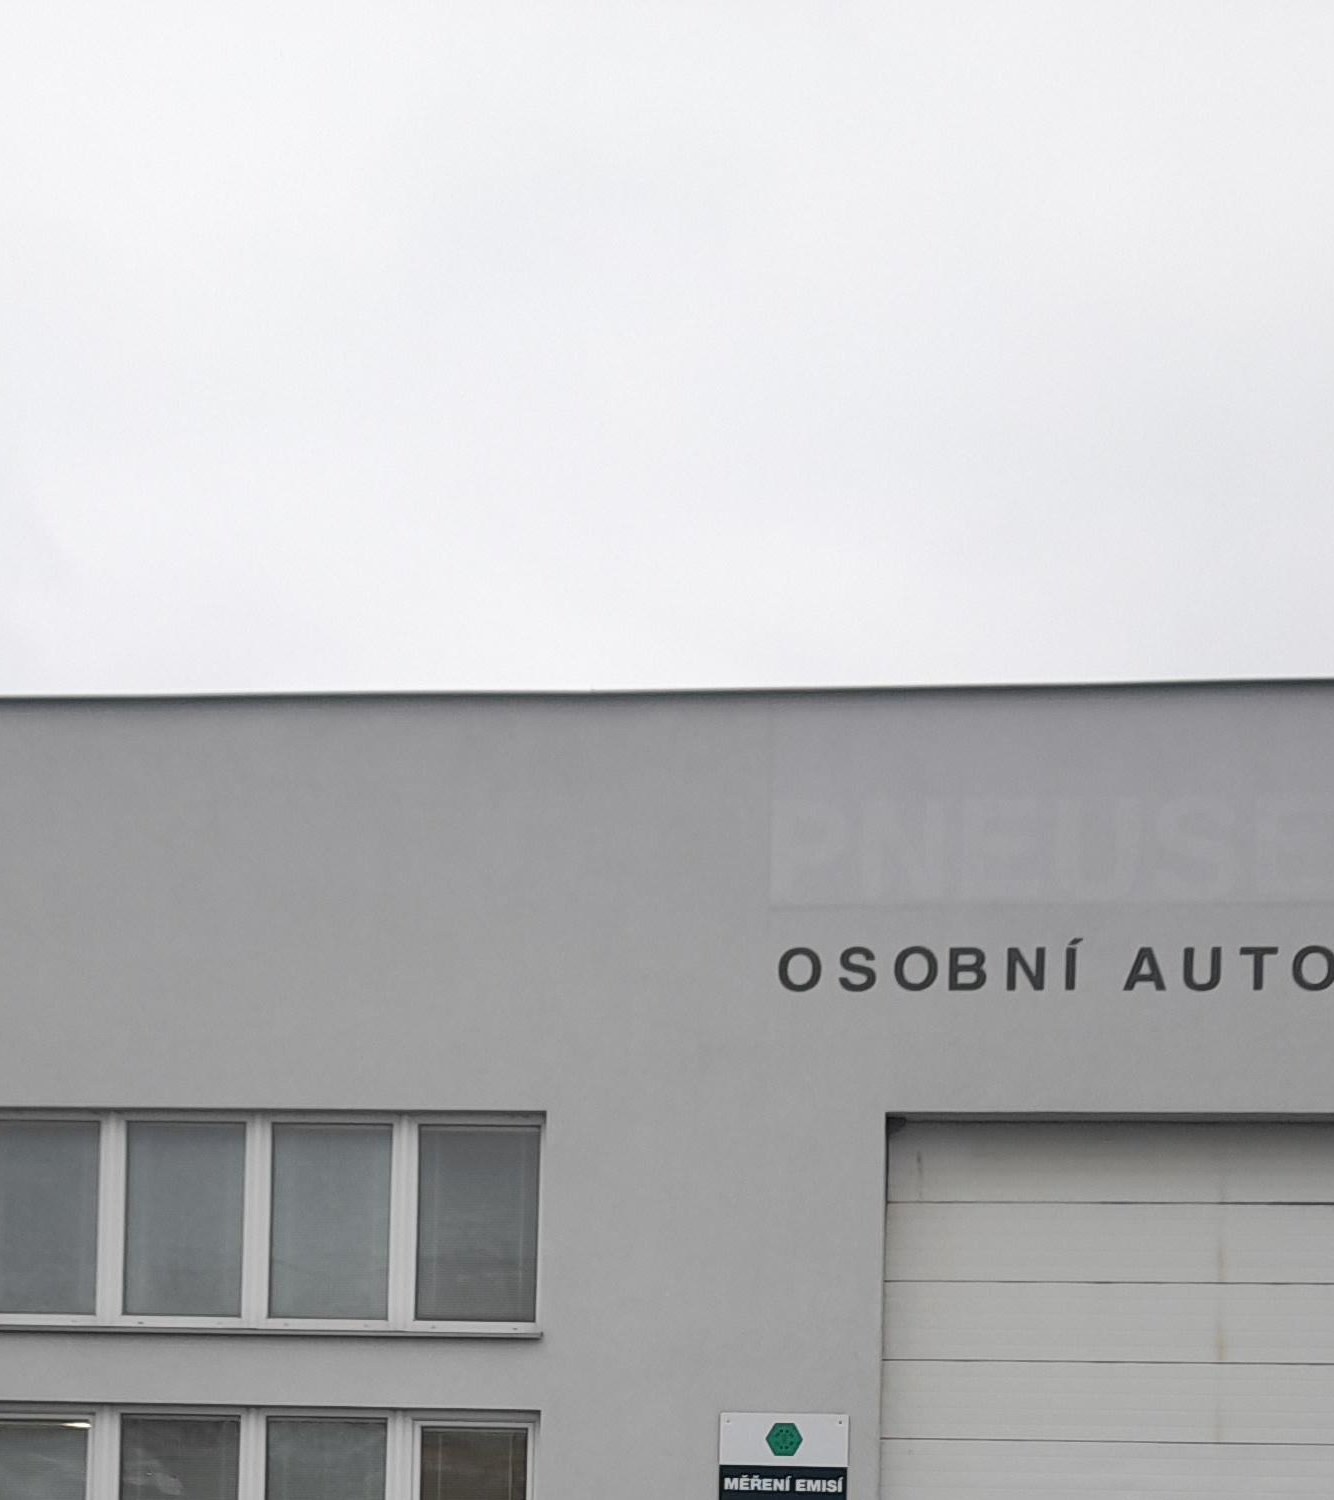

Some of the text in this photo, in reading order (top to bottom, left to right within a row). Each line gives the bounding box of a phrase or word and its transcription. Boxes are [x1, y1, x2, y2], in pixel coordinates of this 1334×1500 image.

[777, 938, 1084, 993] OSOBNÍ
[724, 1474, 844, 1493] MĚŘENÍ EMISÍ
